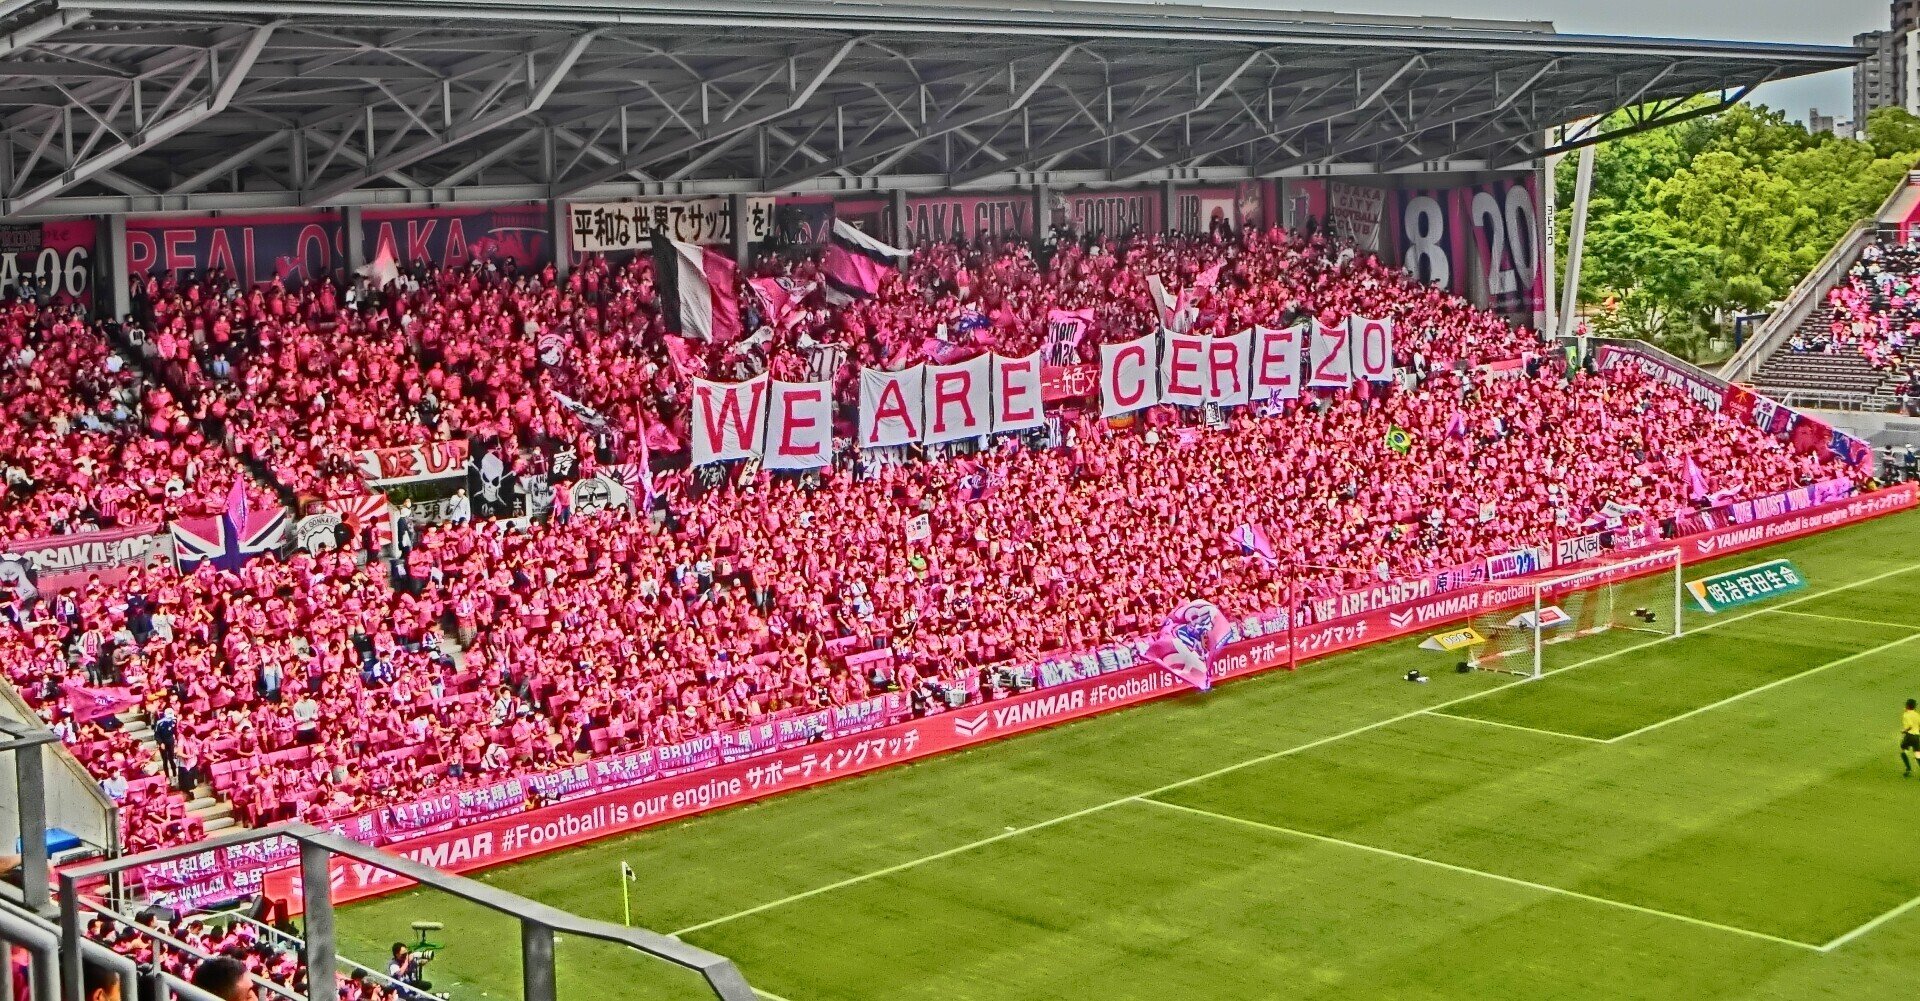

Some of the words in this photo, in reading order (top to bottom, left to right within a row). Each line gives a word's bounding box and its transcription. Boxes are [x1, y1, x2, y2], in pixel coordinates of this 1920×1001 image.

[574, 203, 773, 248] 平和な世界でサッカを!
[1404, 195, 1450, 291] 8
[1472, 184, 1538, 295] 20
[127, 228, 273, 291] REAL
[697, 380, 821, 455] WE
[869, 360, 1035, 443] ARE
[1112, 323, 1386, 407] CEREZO
[1717, 525, 1763, 548] YANMAR
[1765, 516, 1801, 538] #Football
[1801, 516, 1809, 529] is
[1809, 514, 1824, 526] our
[1822, 508, 1848, 524] engine
[1733, 501, 1753, 524] WE
[1753, 493, 1786, 520] MUST
[24, 542, 108, 570] OSAKA
[1707, 566, 1801, 603] 明治安田生命
[1313, 597, 1337, 622] WE
[1341, 590, 1369, 617] ARE
[1416, 592, 1479, 623] YANMAR
[993, 690, 1084, 729] YANMAR
[1090, 673, 1157, 706] #Football
[1160, 671, 1172, 687] is
[659, 736, 712, 761] BRUNO
[458, 779, 523, 808] 新井晴樹
[502, 798, 605, 851] #Football
[610, 803, 628, 824] is
[632, 795, 667, 814] our
[672, 777, 741, 811] engine
[745, 728, 921, 790] サポーティングマッチ
